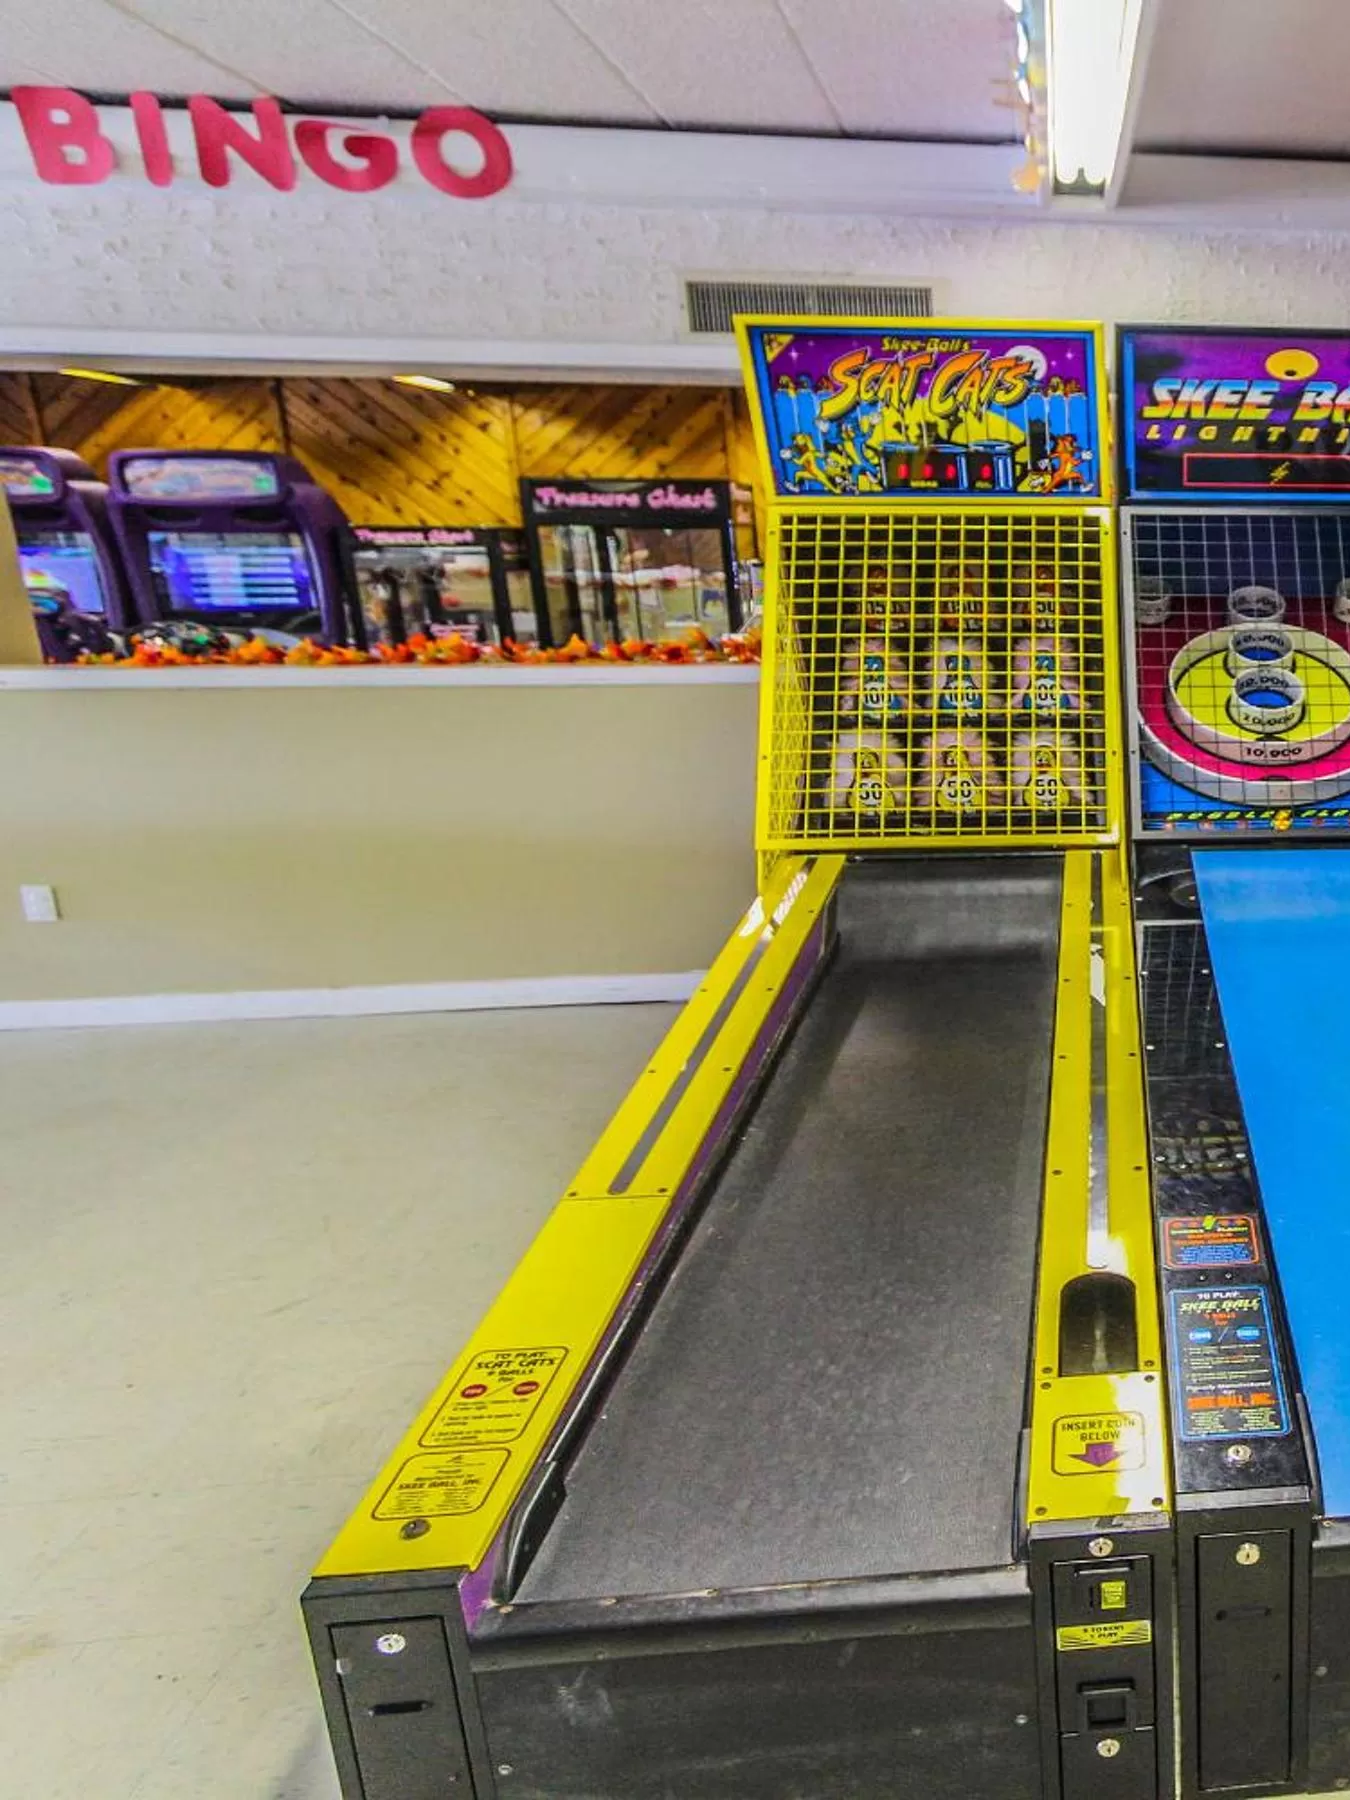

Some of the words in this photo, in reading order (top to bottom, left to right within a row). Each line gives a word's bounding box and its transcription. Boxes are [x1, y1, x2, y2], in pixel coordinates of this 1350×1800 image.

[11, 86, 513, 198] BINGO
[821, 348, 936, 420] SCAT
[929, 349, 1032, 417] CATS
[1142, 377, 1280, 420] SKEE
[947, 780, 971, 799] 50
[1035, 778, 1057, 797] 50
[1062, 1420, 1103, 1431] INSERT
[1080, 1431, 1120, 1441] BELOW
